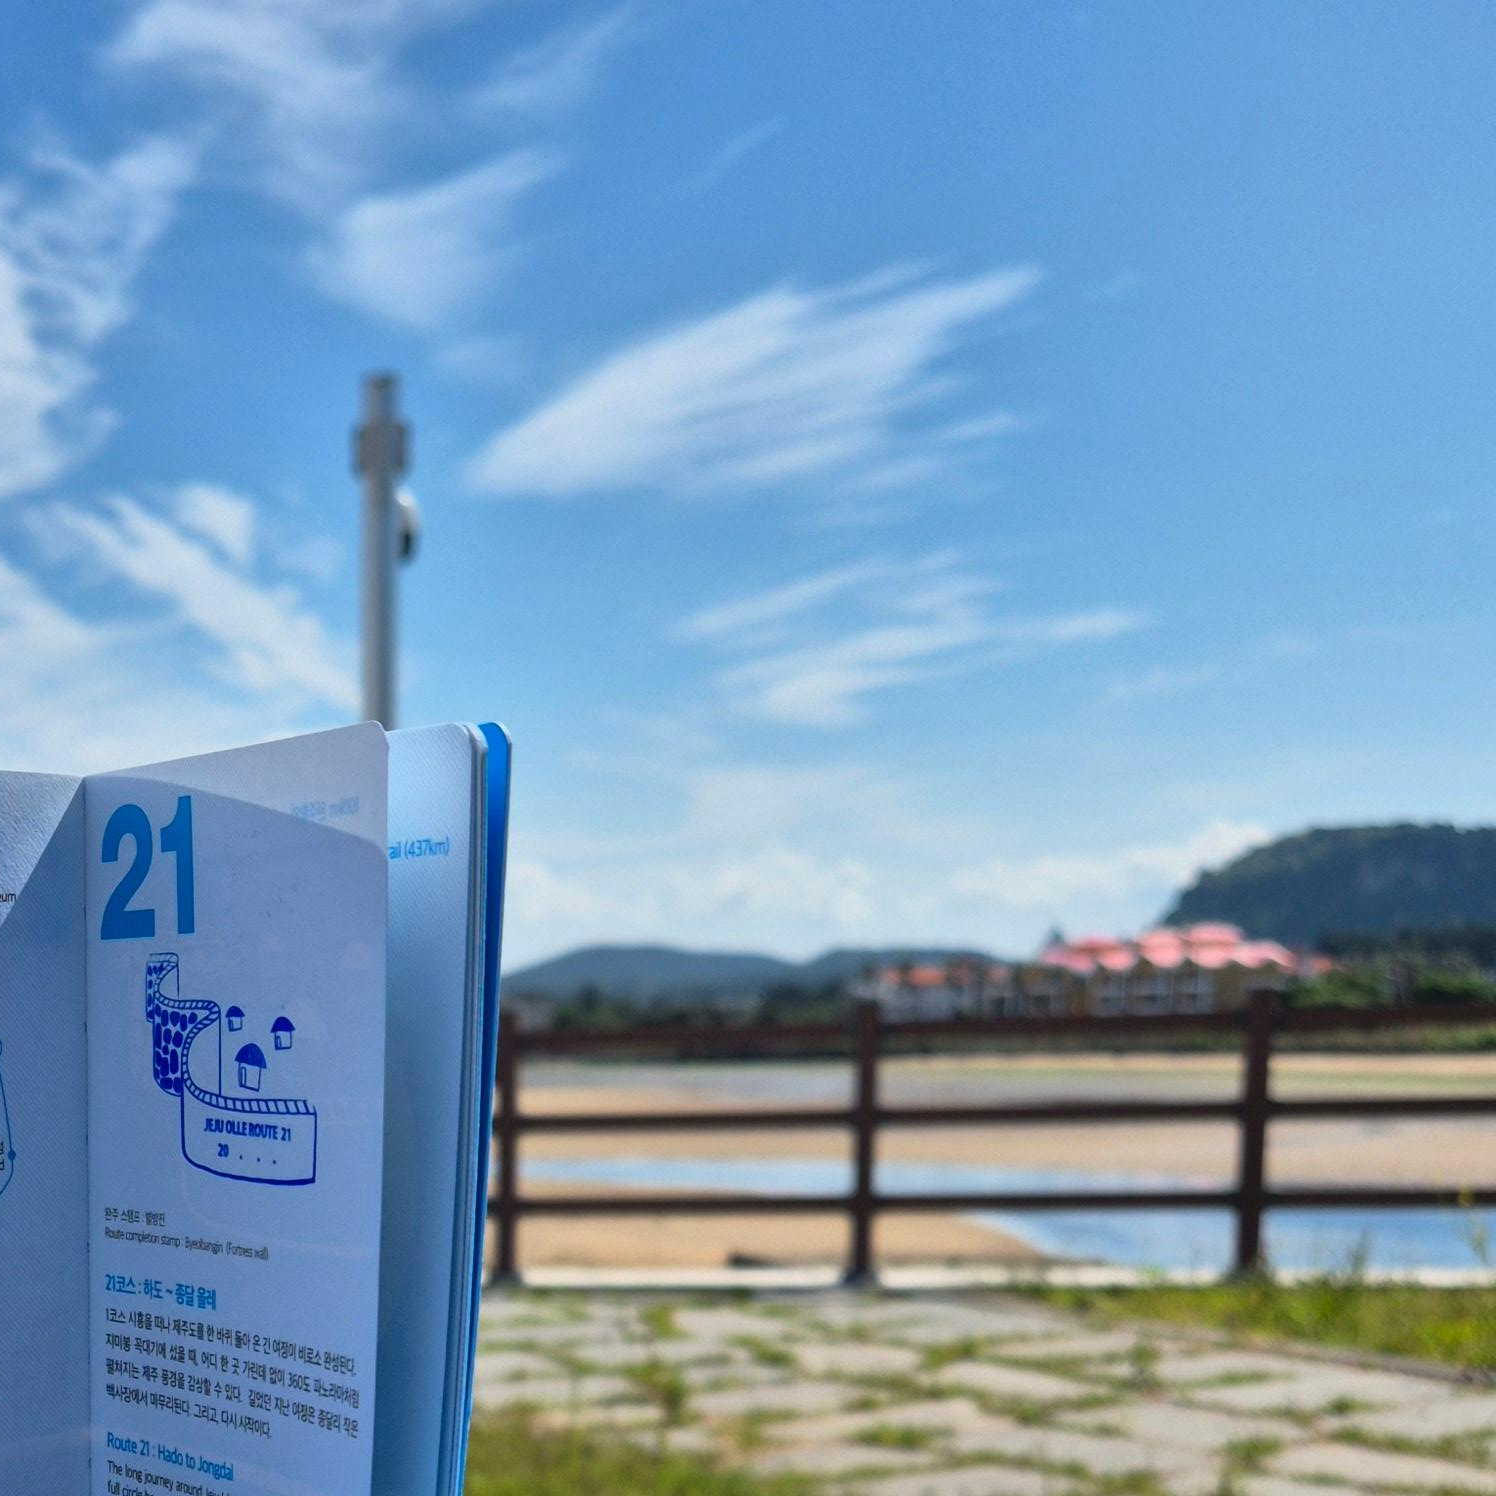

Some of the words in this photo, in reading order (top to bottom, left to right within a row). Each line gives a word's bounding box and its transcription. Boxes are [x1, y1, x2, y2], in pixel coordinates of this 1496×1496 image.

[404, 837, 449, 858] (437km)
[100, 795, 195, 940] 21
[204, 1117, 224, 1133] JEJU
[225, 1120, 247, 1137] OLLE
[249, 1122, 278, 1140] ROUTE
[281, 1127, 292, 1141] 21
[217, 1143, 229, 1157] 20
[105, 1274, 136, 1294] 21코스
[143, 1279, 164, 1300] 하도
[175, 1283, 195, 1307] 종달
[197, 1286, 216, 1310] 올레
[105, 1308, 126, 1323] 1코스
[129, 1310, 153, 1330] 시흥을
[154, 1316, 170, 1333] 떠나
[173, 1319, 204, 1340] 제주도를
[207, 1325, 214, 1342] 한
[216, 1328, 232, 1345] 바퀴
[273, 1339, 296, 1360] 여정이
[298, 1346, 322, 1366] 비로소
[105, 1333, 131, 1352] 지미봉
[134, 1337, 166, 1359] 꼭대기에
[202, 1352, 217, 1370] 어디
[220, 1355, 228, 1372] 한
[269, 1366, 285, 1387] 없이
[288, 1372, 311, 1393] 360도
[106, 1358, 140, 1379] 펼쳐지는
[142, 1365, 158, 1382] 제주
[162, 1369, 185, 1390] 풍경을
[188, 1375, 211, 1396] 감상할
[214, 1382, 222, 1398] 수
[248, 1389, 271, 1411] 길었던
[274, 1397, 290, 1416] 지난
[292, 1401, 315, 1424] 여정은
[318, 1409, 341, 1432] 종달리
[221, 1411, 237, 1430] 다시
[107, 1432, 137, 1454] Route
[140, 1440, 150, 1456] 21
[157, 1443, 183, 1466] Hado
[185, 1453, 196, 1470] to
[198, 1456, 234, 1481] Jongdal
[107, 1460, 123, 1475] The
[125, 1462, 142, 1483] long
[144, 1469, 173, 1491] journey
[108, 1480, 120, 1494] full
